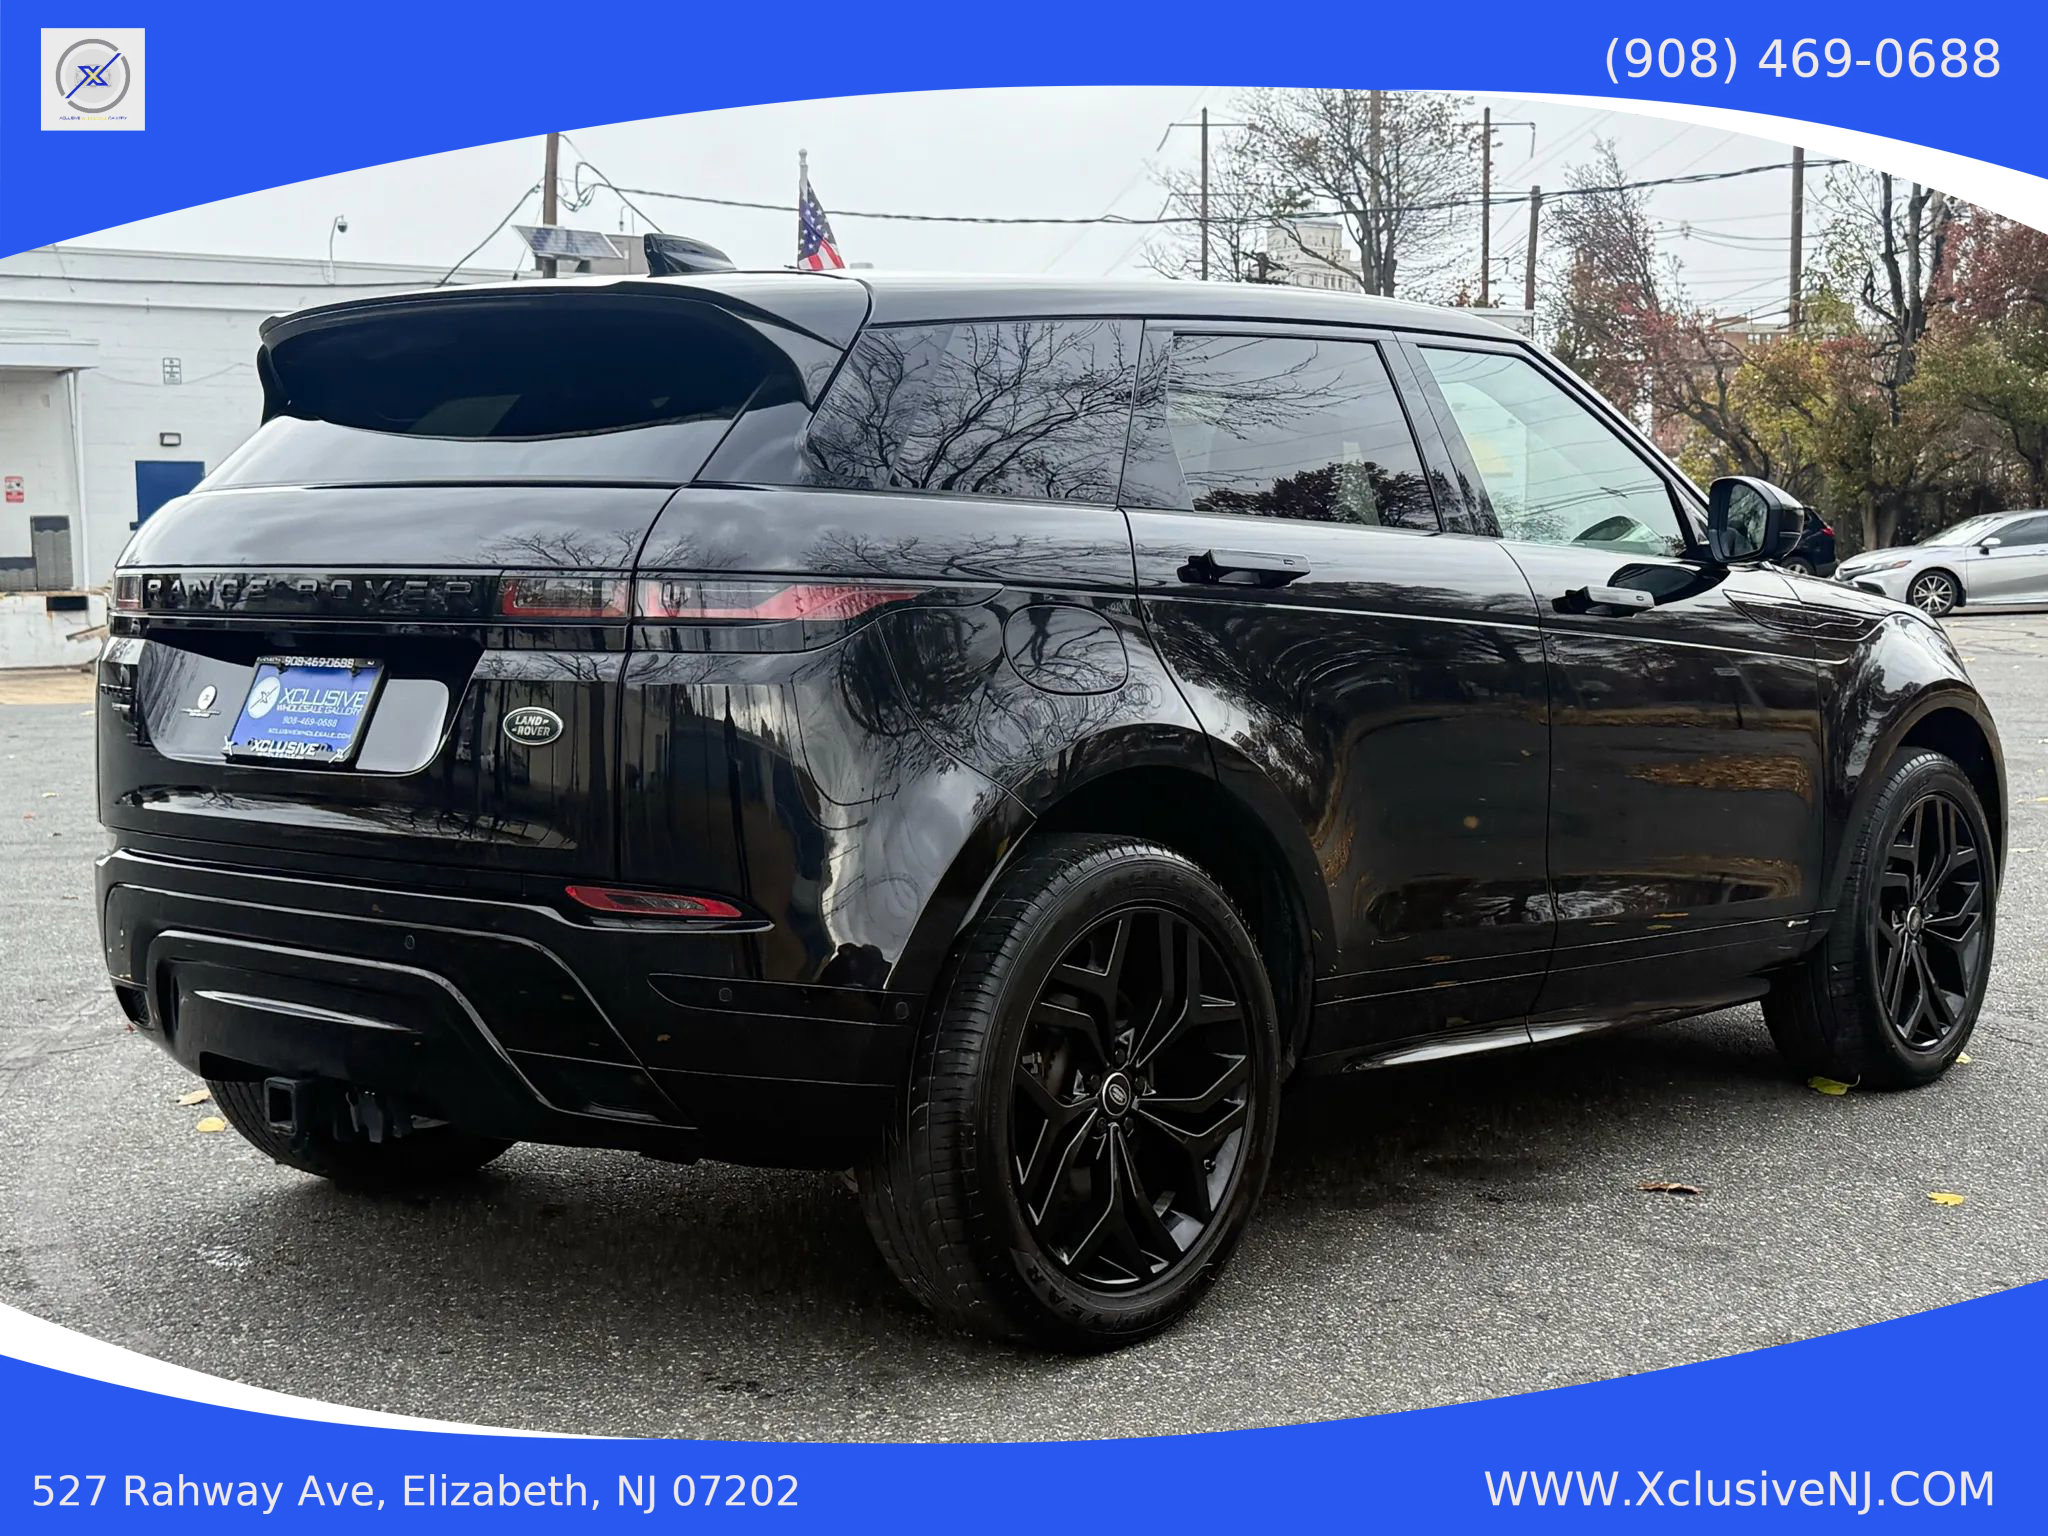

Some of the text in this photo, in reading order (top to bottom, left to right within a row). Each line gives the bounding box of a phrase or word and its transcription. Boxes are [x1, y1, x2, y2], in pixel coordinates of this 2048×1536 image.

[146, 578, 477, 606] RANGE ROVER
[279, 688, 368, 708] XCLUSIVE
[514, 715, 542, 726] LAND
[516, 725, 551, 736] ROVER
[250, 739, 320, 754] XCLUSIVE
